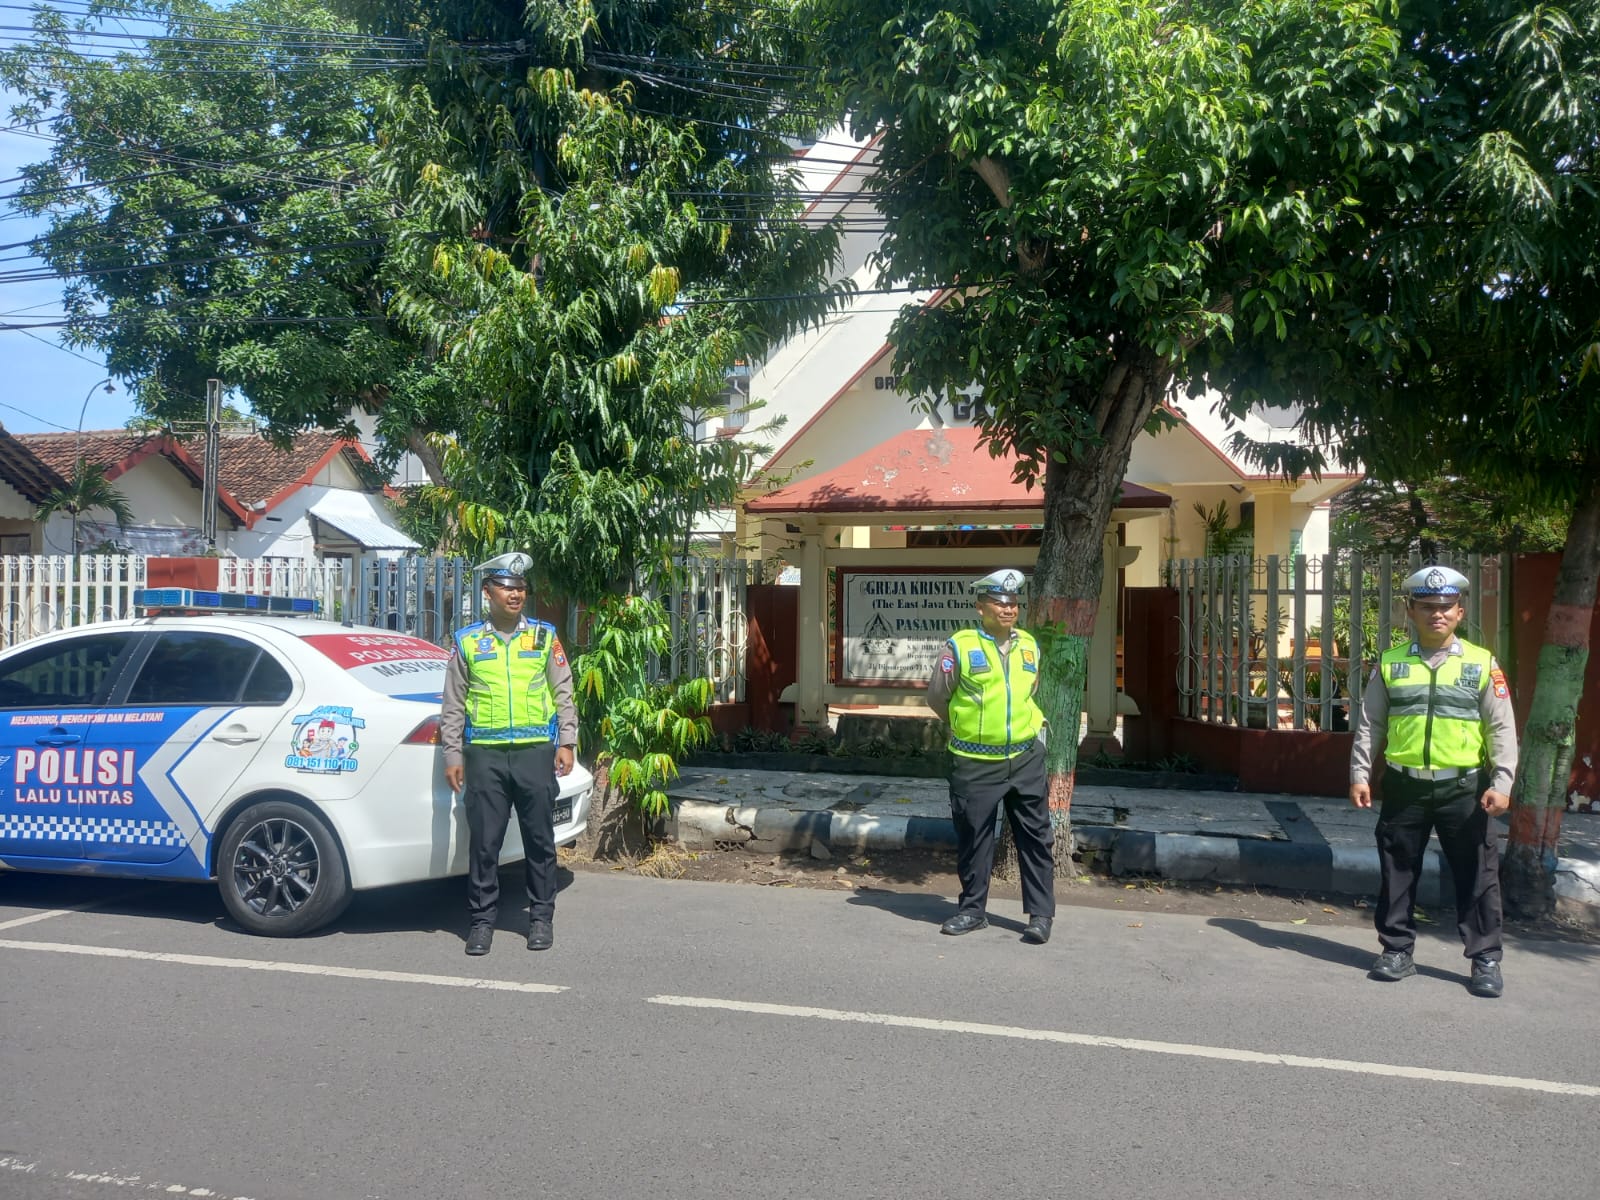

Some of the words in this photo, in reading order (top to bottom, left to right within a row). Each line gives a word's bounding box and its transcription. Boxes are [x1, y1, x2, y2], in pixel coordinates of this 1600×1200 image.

[865, 581, 907, 595] GREJA
[910, 581, 964, 595] KRISTEN
[872, 599, 894, 610] (The
[897, 599, 918, 609] East
[921, 599, 944, 609] Java
[349, 649, 409, 662] POLRI
[107, 713, 123, 722] DAN
[125, 712, 164, 722] MELAYANI
[15, 747, 136, 785] POLISI
[286, 756, 304, 767] 081
[306, 757, 321, 768] 151
[323, 758, 339, 769] 110
[341, 759, 357, 770] 110
[15, 788, 61, 803] LALU
[67, 789, 134, 805] LINTAS
